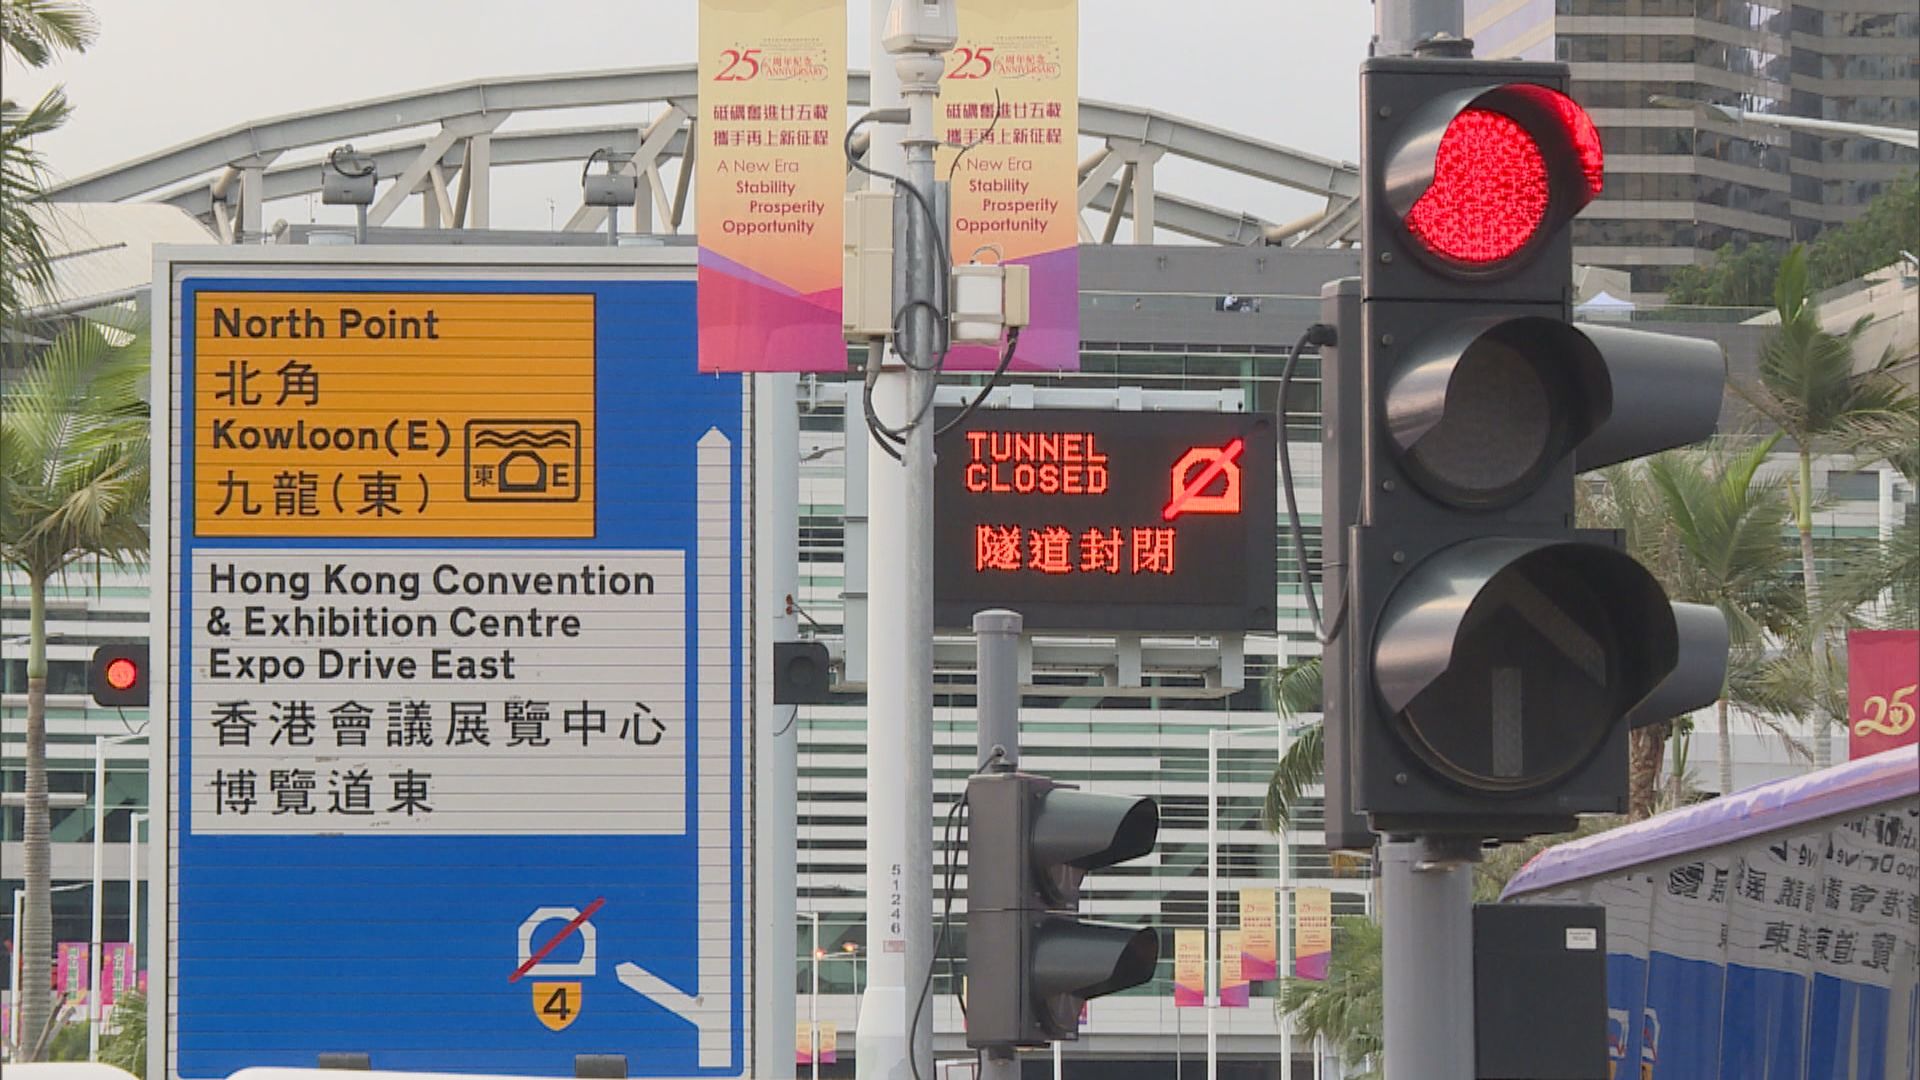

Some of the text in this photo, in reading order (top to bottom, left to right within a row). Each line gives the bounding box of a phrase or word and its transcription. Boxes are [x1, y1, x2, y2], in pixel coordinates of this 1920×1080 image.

[713, 49, 762, 81] 25
[946, 47, 994, 79] 25
[717, 160, 799, 173] A New Era
[967, 158, 1002, 171] New
[1008, 157, 1033, 171] Era
[736, 180, 797, 196] Stability
[969, 178, 1029, 195] Stability
[749, 200, 825, 216] Prosperity
[982, 198, 1058, 214] Prosperity
[722, 219, 815, 236] Opportunity
[955, 218, 1048, 234] Opportunity
[213, 308, 440, 340] North Point
[215, 360, 319, 407] 北角
[212, 418, 451, 458] Kowloon(E)
[966, 431, 1108, 463] TUNNEL
[473, 464, 496, 488] 東
[552, 464, 570, 487] E
[966, 463, 1108, 495] CLOSED
[975, 524, 1176, 575] 隧道封閉
[211, 564, 655, 600] Hong Kong Convention
[207, 606, 581, 638] & Exhibition Centre
[210, 649, 516, 684] Expo Drive East
[210, 699, 667, 748] 香港會議展覽中心
[1854, 684, 1918, 737] 25
[210, 768, 434, 817] 博覽道東
[890, 863, 902, 934] 51246
[543, 988, 571, 1021] 4
